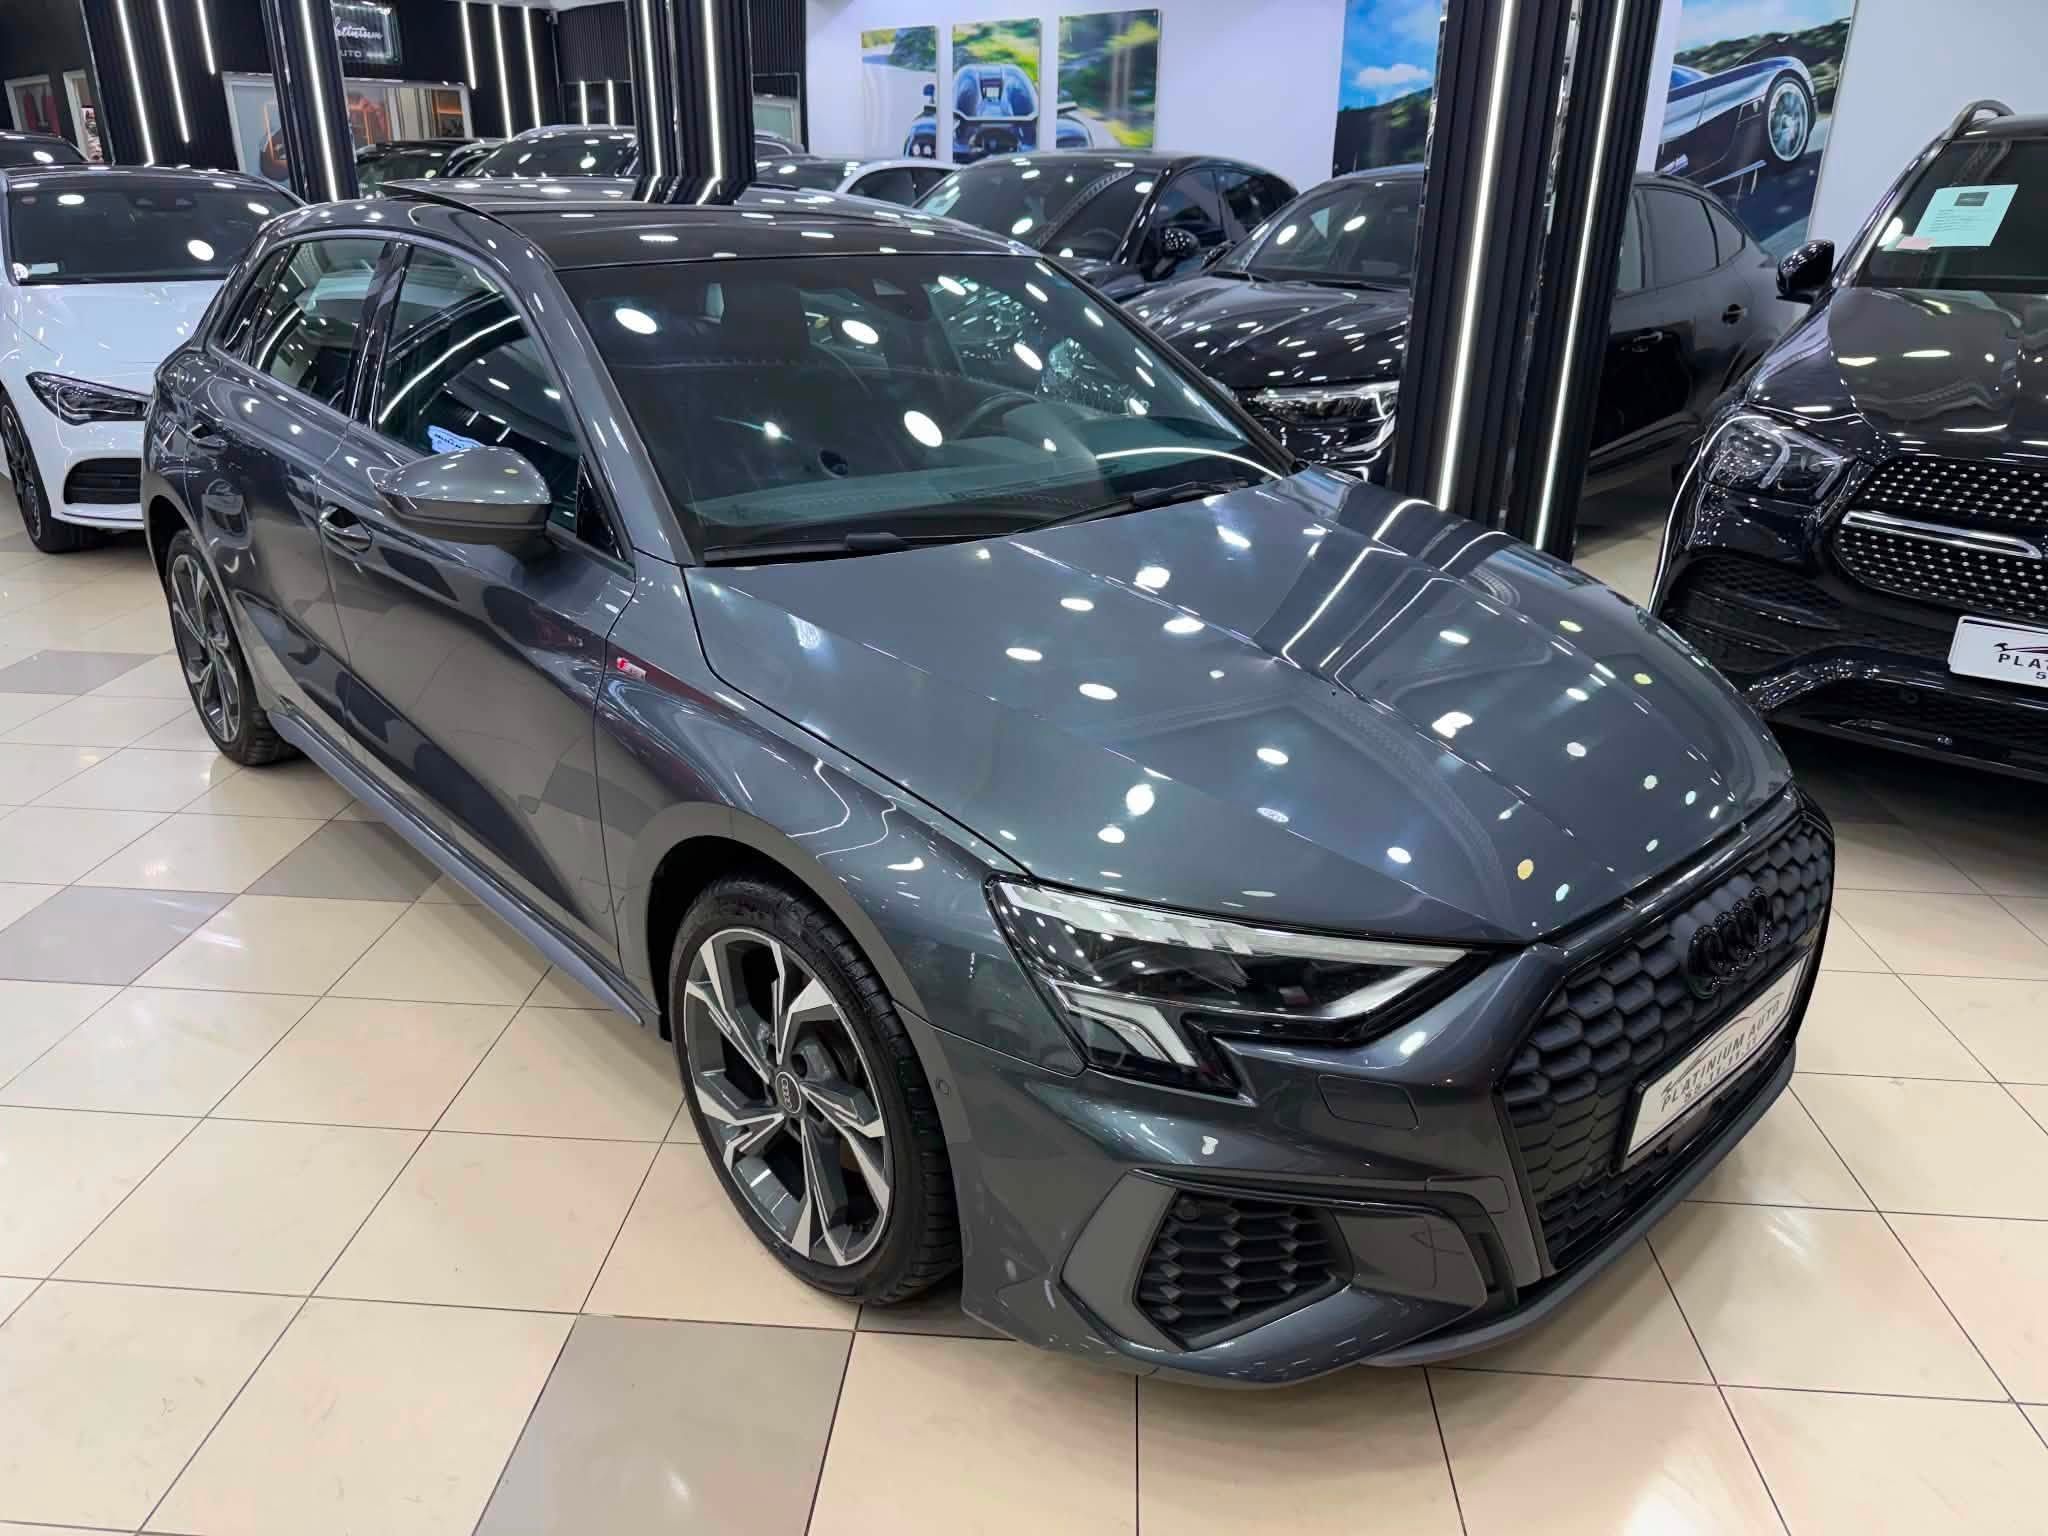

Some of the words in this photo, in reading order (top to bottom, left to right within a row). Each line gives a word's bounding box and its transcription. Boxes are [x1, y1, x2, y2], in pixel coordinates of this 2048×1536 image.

[339, 49, 361, 58] UTO
[1998, 653, 2048, 670] PLA
[1661, 1033, 1745, 1112] PLATINIUM
[1748, 999, 1780, 1038] AUTO
